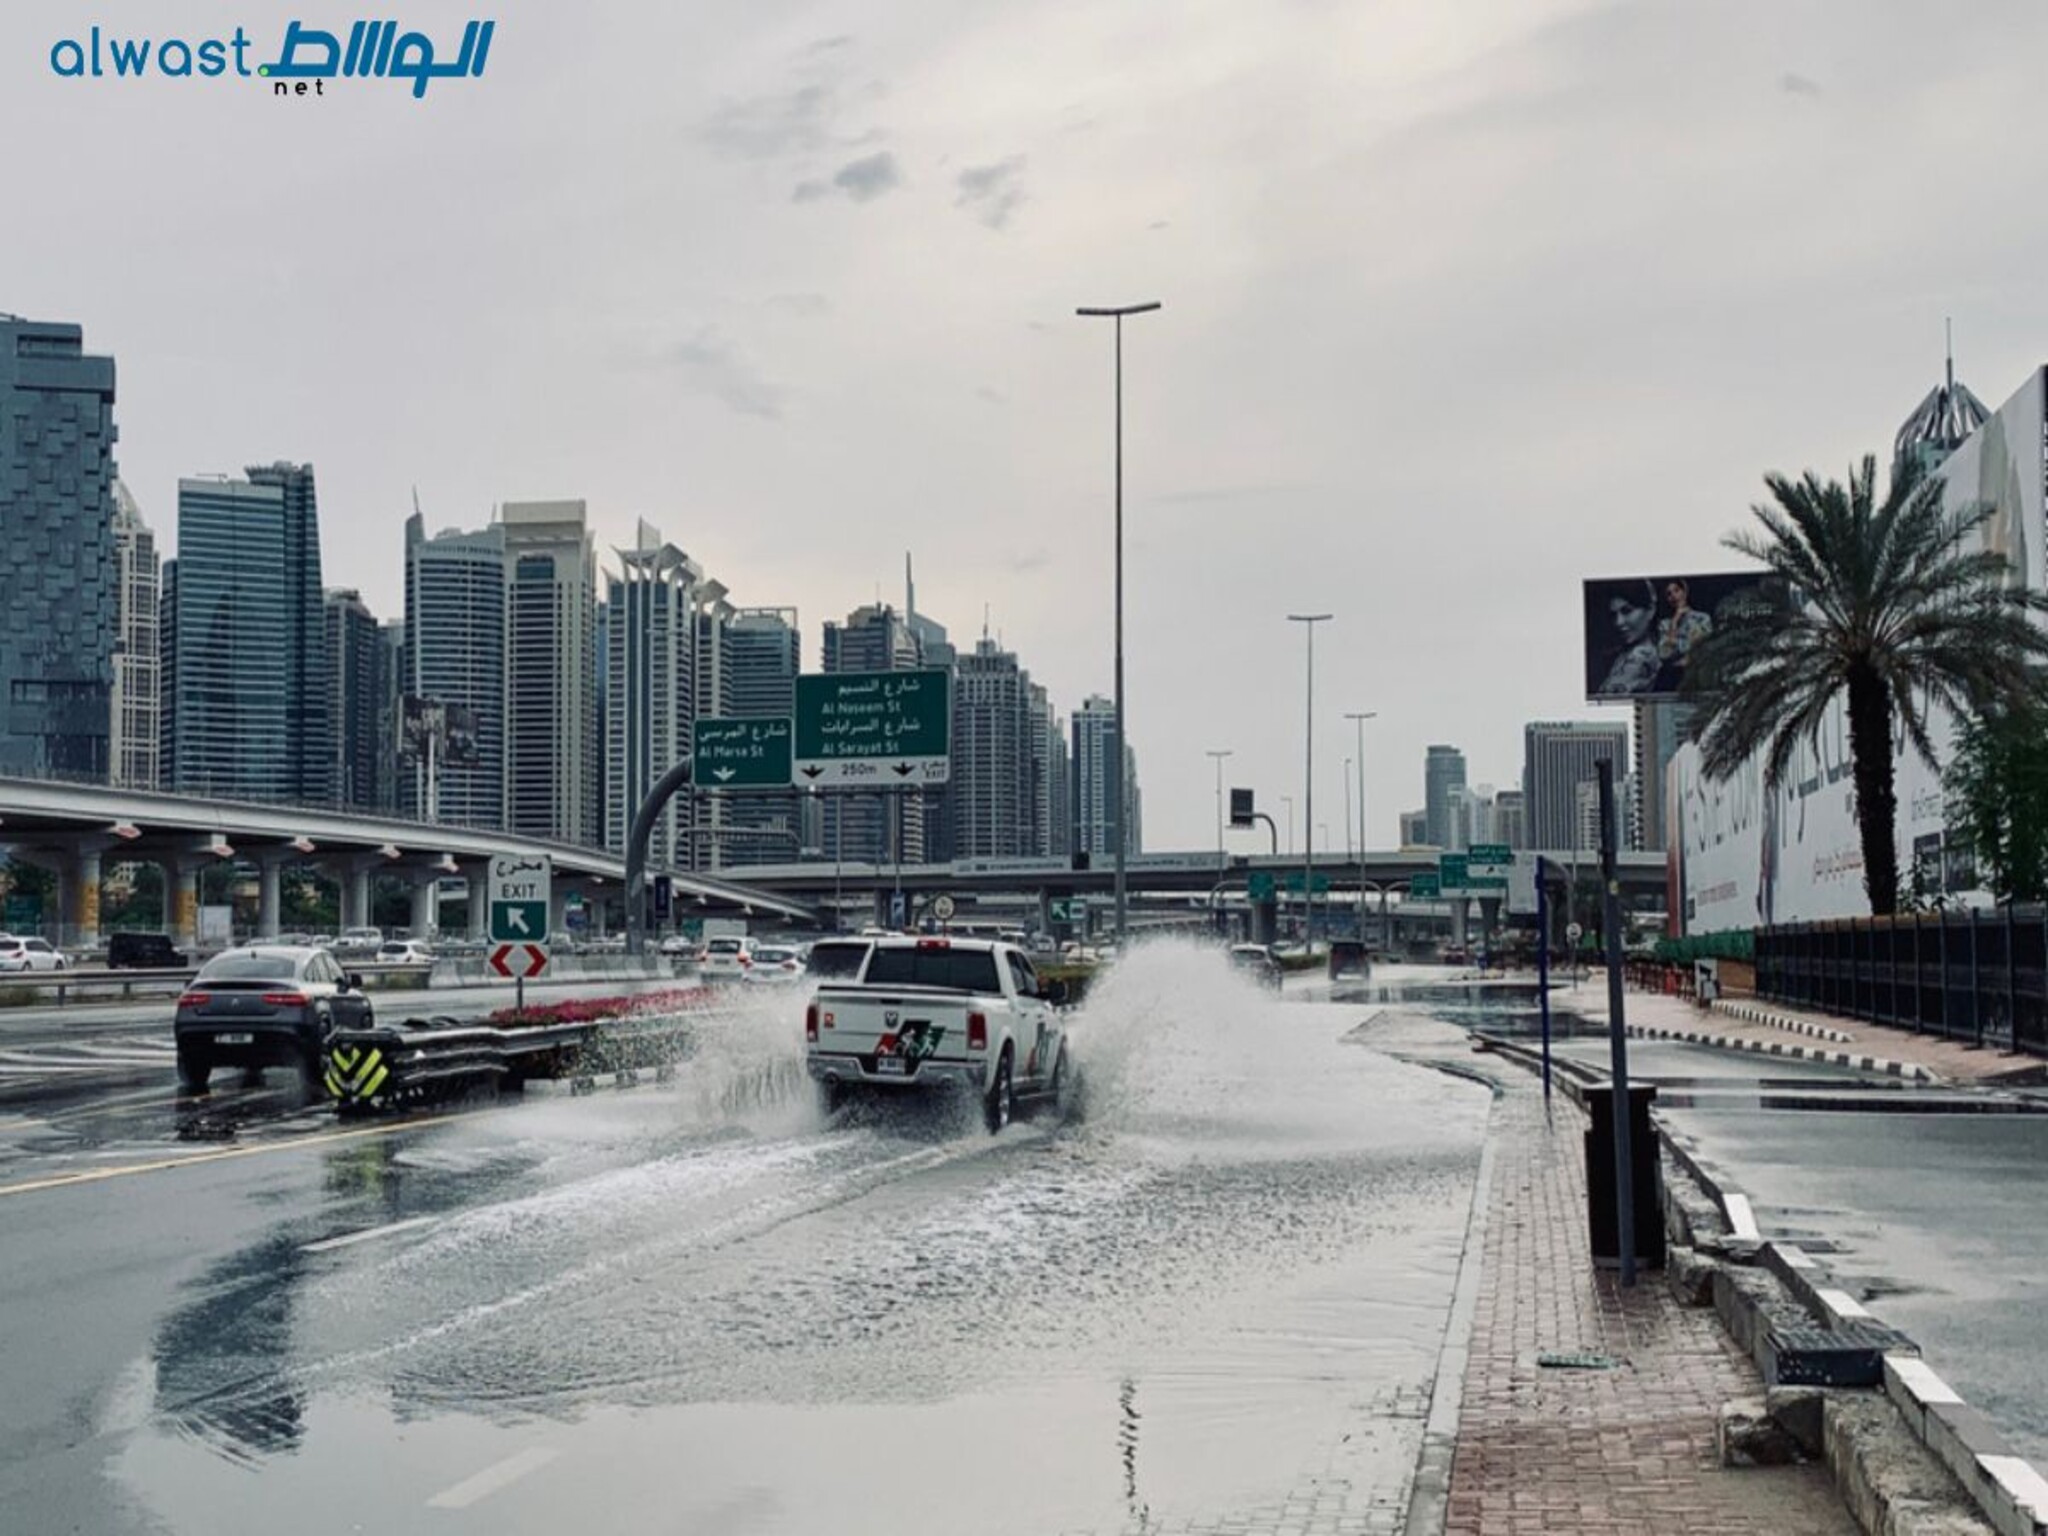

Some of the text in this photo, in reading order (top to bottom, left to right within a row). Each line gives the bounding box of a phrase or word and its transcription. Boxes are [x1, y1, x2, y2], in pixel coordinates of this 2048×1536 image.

[838, 678, 921, 698] شارع النسيم
[821, 702, 834, 714] Al
[887, 700, 901, 713] St
[751, 722, 788, 742] شارع
[884, 716, 921, 736] شارع
[698, 746, 711, 758] Al
[750, 744, 764, 758] St
[822, 740, 900, 756] Al Sarayat St
[841, 763, 877, 776] 250m
[496, 859, 543, 877] مخرج
[502, 884, 536, 899] EXIT
